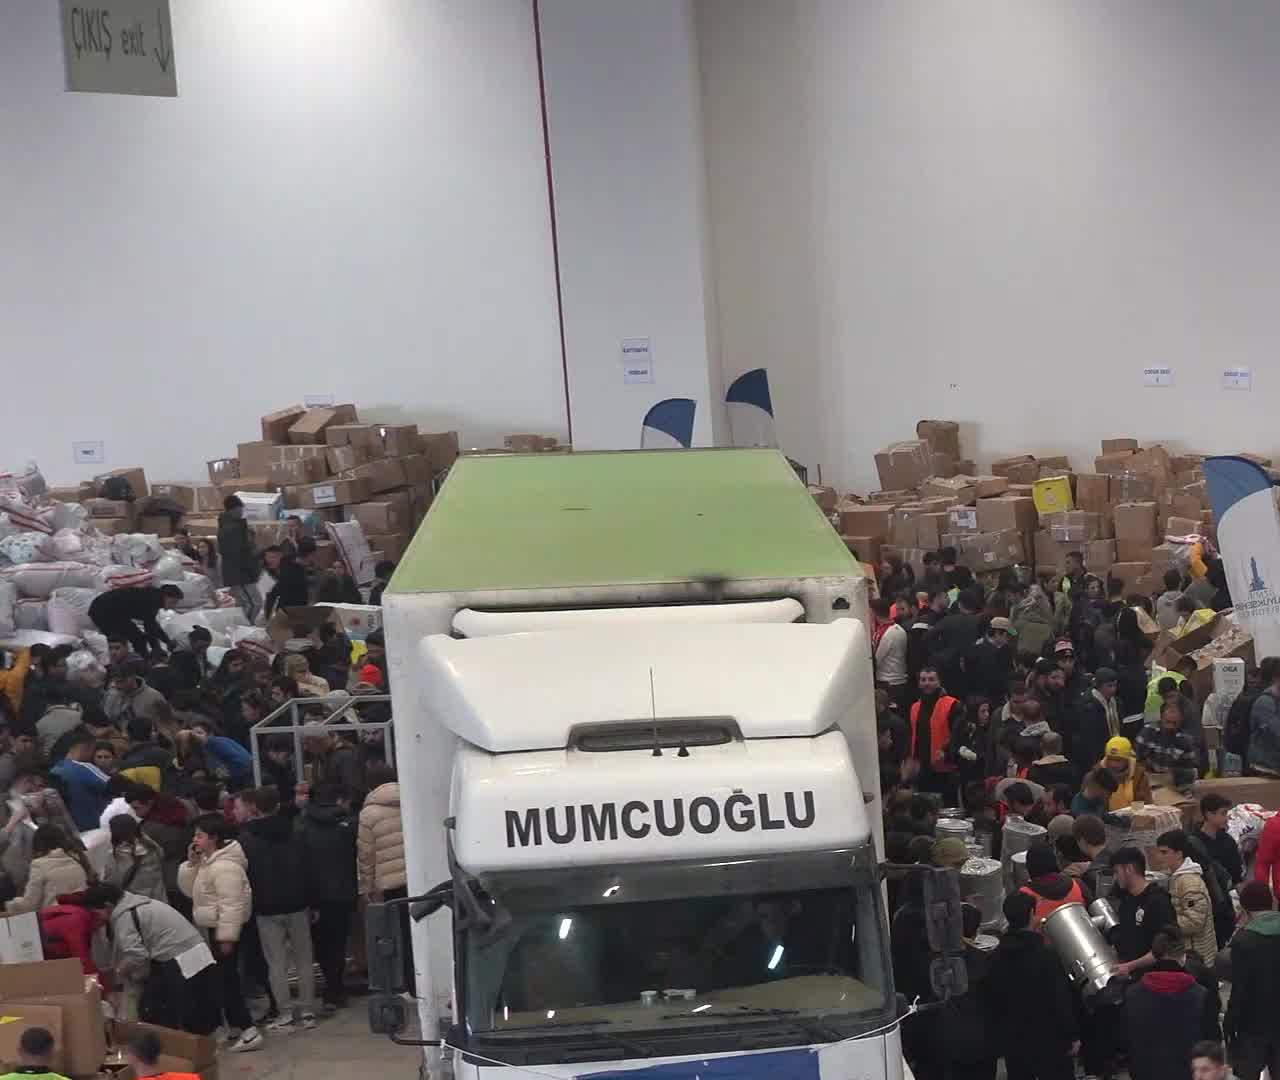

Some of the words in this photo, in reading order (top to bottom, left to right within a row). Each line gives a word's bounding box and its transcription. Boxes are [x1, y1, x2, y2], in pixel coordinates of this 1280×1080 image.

[71, 7, 112, 62] ÇIKIŞ
[121, 24, 146, 56] exit
[504, 788, 816, 848] MUMCUOĞLU
